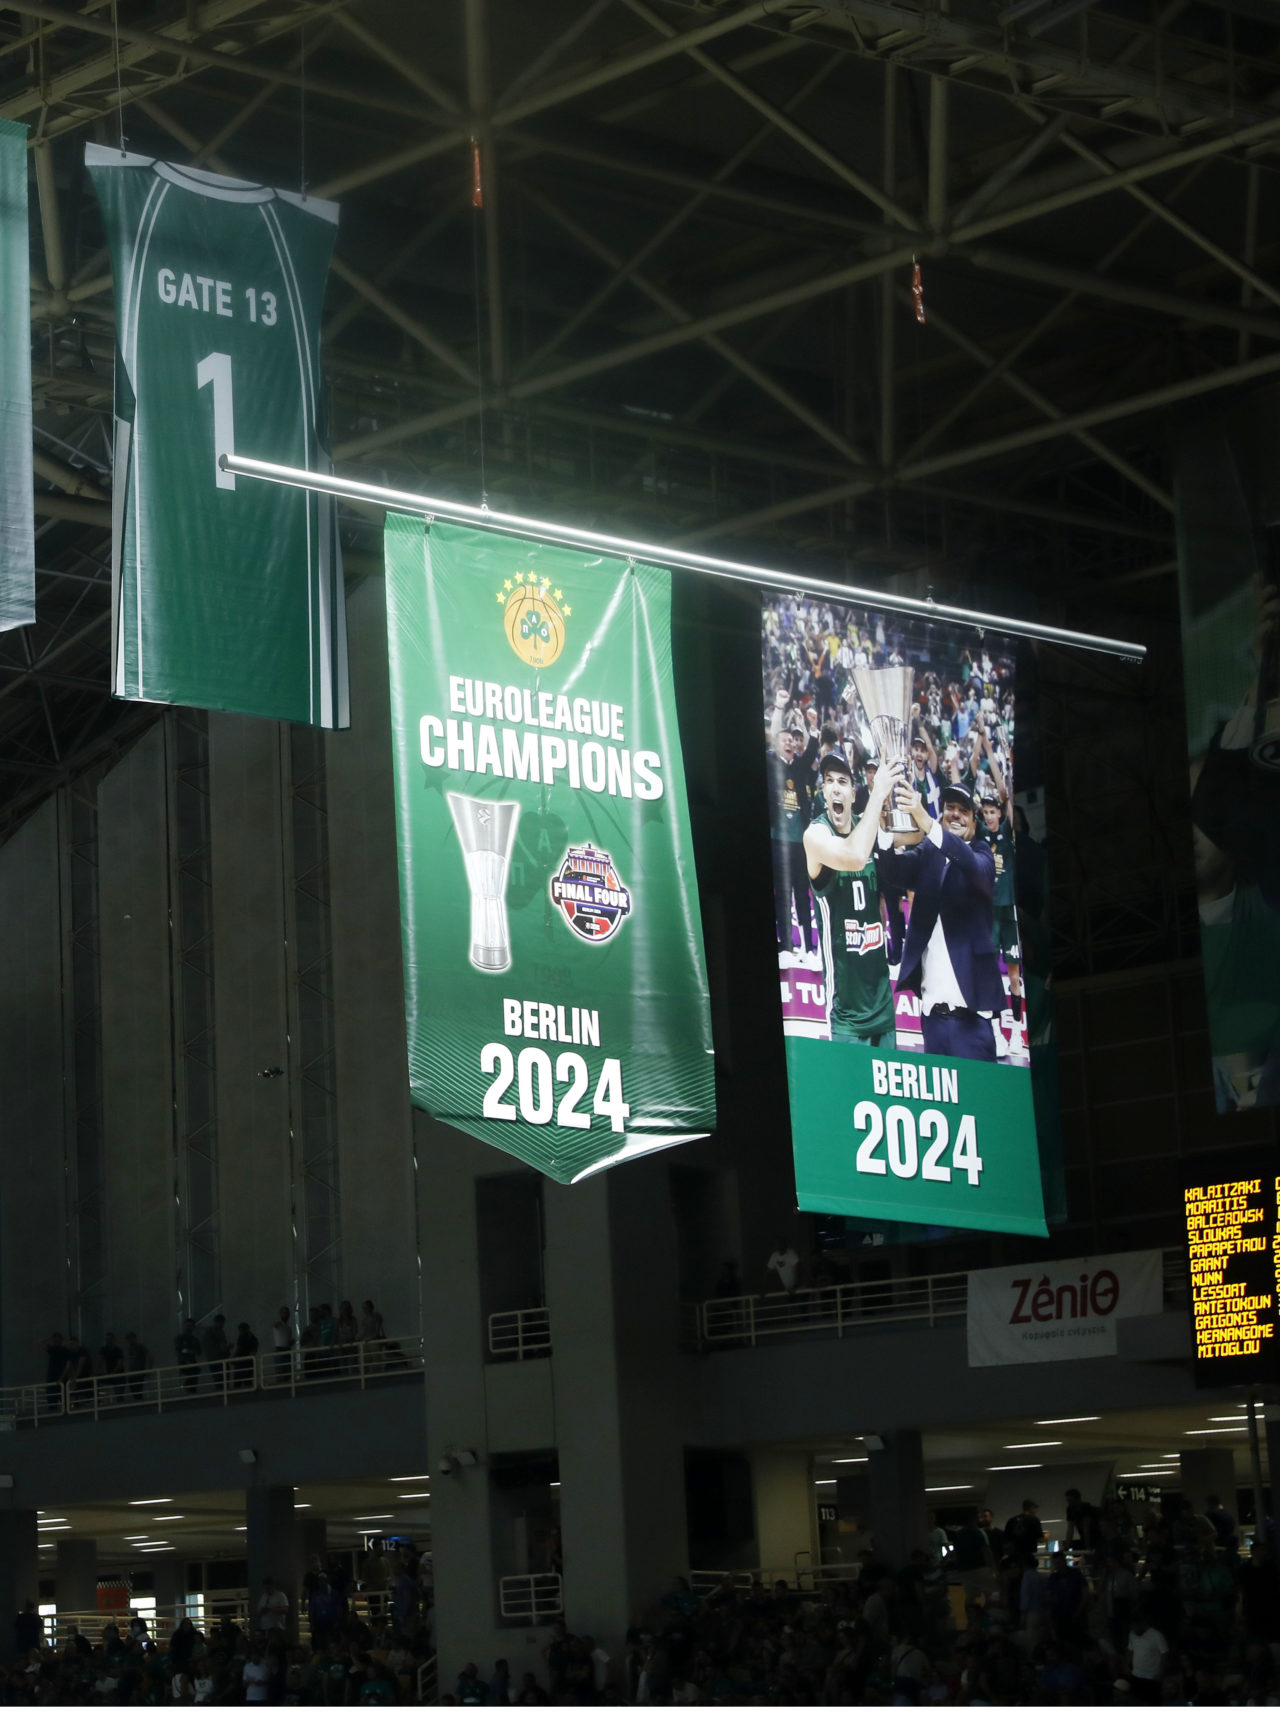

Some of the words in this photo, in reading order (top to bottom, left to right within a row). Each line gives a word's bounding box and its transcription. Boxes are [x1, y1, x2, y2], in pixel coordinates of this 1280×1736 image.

[157, 268, 233, 318] GATE
[245, 287, 277, 327] 13
[196, 352, 236, 491] 1
[449, 675, 625, 742] EUROLEAGUE
[419, 714, 664, 801] CHAMPIONS
[554, 881, 593, 902] FINAL
[593, 887, 628, 908] FOUR
[503, 998, 601, 1047] BERLIN
[480, 1042, 630, 1133] 2024
[872, 1059, 959, 1104] BERLIN
[853, 1100, 983, 1186] 2024
[1184, 1179, 1261, 1202] KALAITZAKI
[1185, 1195, 1247, 1216] MORAITIS
[1187, 1208, 1264, 1230] BALCEROWSK
[1188, 1225, 1242, 1245] SLOUKAS
[1189, 1236, 1267, 1259] PAPAPETROU
[1190, 1255, 1229, 1273] GRANT
[1191, 1270, 1223, 1287] NUNN
[1192, 1282, 1247, 1302] LESSORT
[1194, 1294, 1272, 1316] ANTETOKOUN
[1195, 1311, 1257, 1330] GRIGONIS
[1196, 1323, 1274, 1344] HERNANGOME
[1197, 1339, 1260, 1359] MITOGLOU
[820, 1507, 836, 1521] 113
